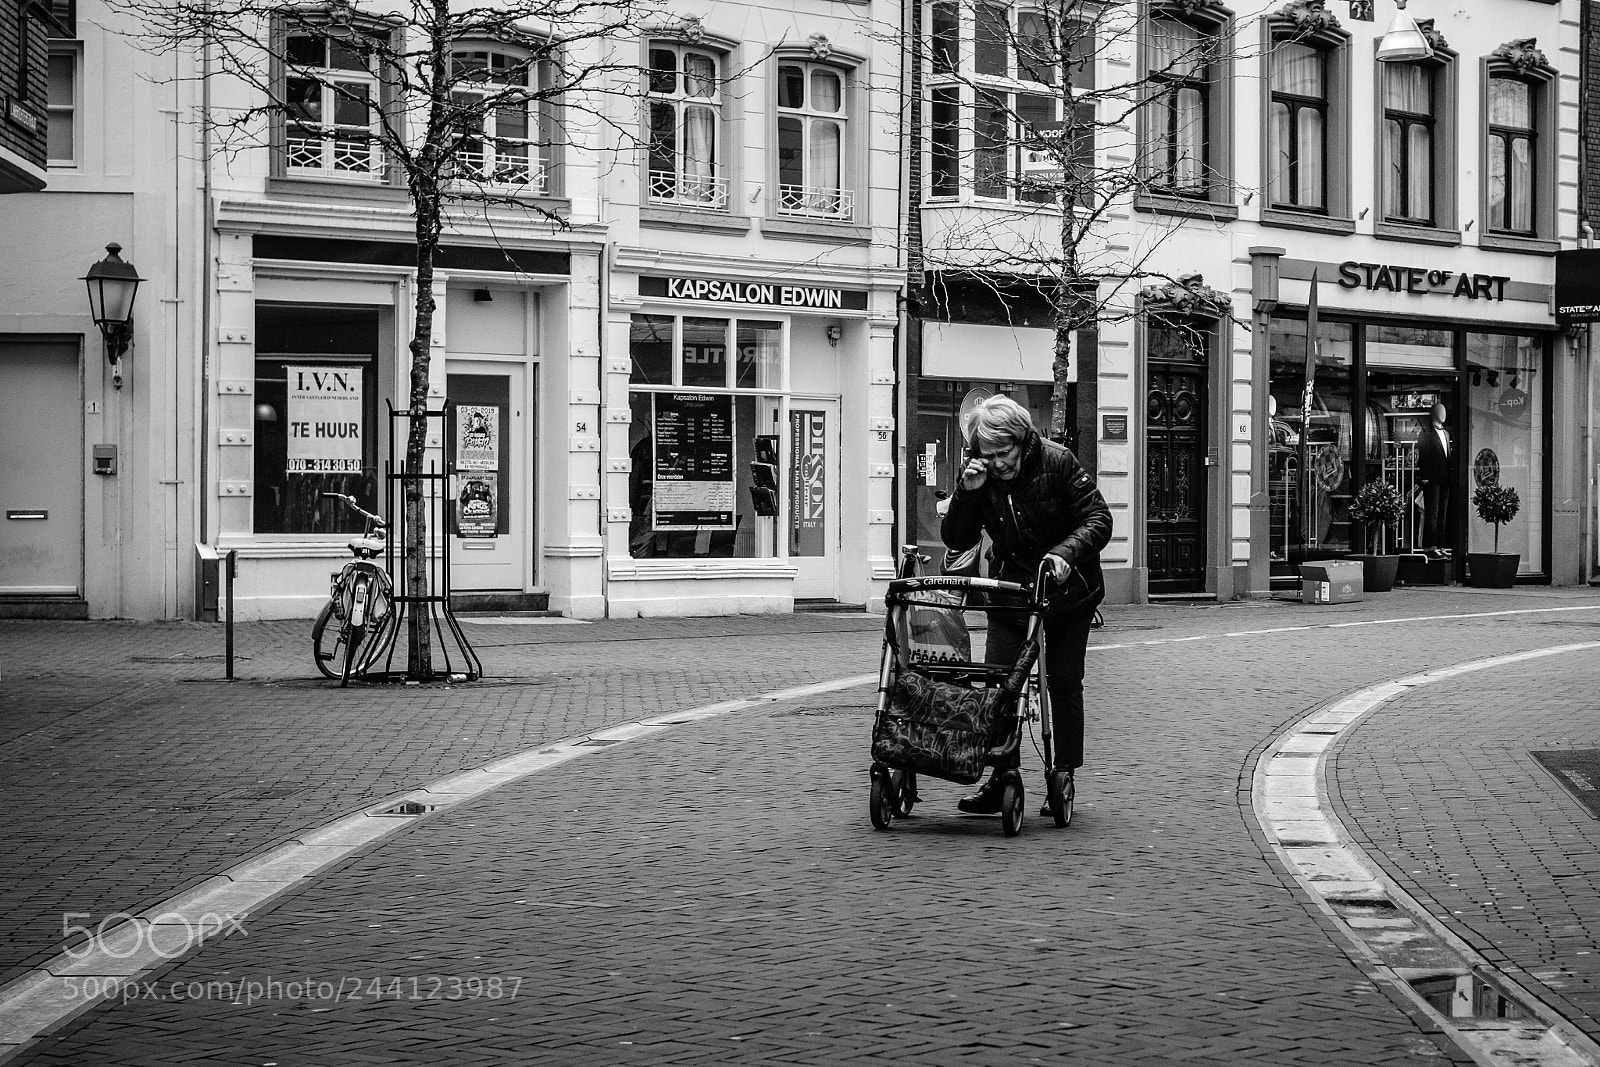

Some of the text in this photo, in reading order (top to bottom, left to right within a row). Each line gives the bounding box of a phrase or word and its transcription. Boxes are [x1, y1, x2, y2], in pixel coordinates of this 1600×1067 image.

[1338, 261, 1511, 302] STATE OF ART
[668, 278, 842, 308] KAPSALON EDWIN
[1559, 305, 1586, 314] STATE
[296, 372, 354, 392] I.V.N.
[673, 394, 698, 402] Kapsalon
[291, 422, 359, 438] TE HUUR
[576, 422, 587, 432] 54
[1239, 425, 1247, 433] 60
[878, 431, 887, 440] 56
[288, 459, 307, 471] 070
[347, 459, 360, 471] 50
[811, 414, 824, 519] DIKSON
[923, 578, 967, 586] caremart
